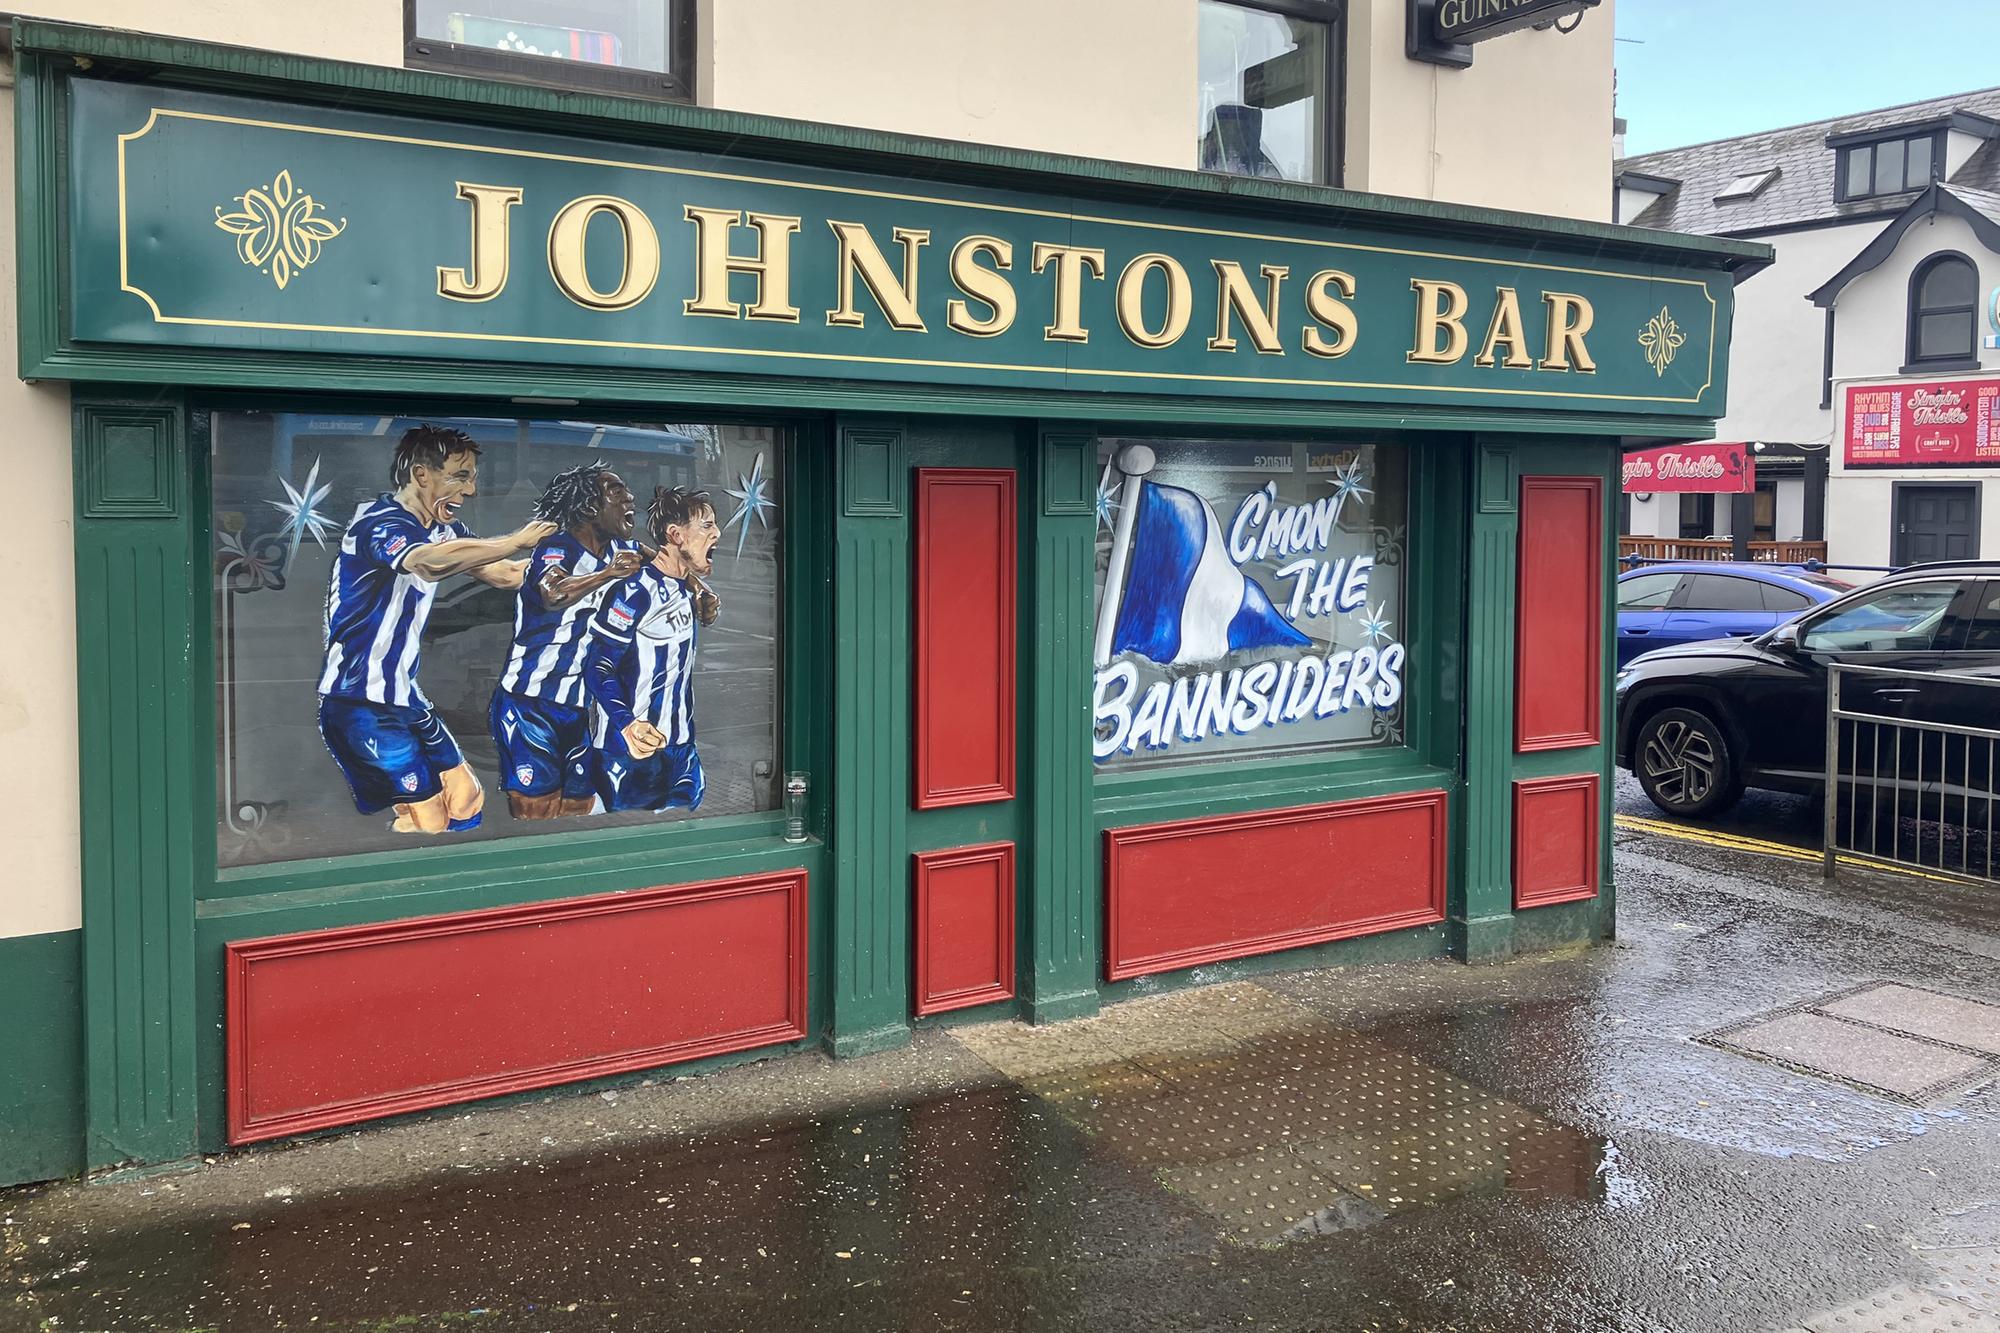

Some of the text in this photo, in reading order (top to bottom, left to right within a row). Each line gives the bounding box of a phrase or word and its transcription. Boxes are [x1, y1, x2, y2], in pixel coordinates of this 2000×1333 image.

[1439, 0, 1534, 28] GUIN
[436, 180, 1597, 375] JOHNSTONS BAR
[1854, 392, 1891, 404] RHYTHM
[1854, 403, 1890, 413] AND BLUES
[1907, 388, 1966, 411] Singin'
[1853, 413, 1864, 440] BOOGIE
[1864, 413, 1881, 426] DUB
[1913, 407, 1968, 426] Thistle
[1657, 453, 1724, 480] Thistle
[1275, 555, 1374, 622] THE
[1093, 643, 1405, 762] BANNSIDERS
